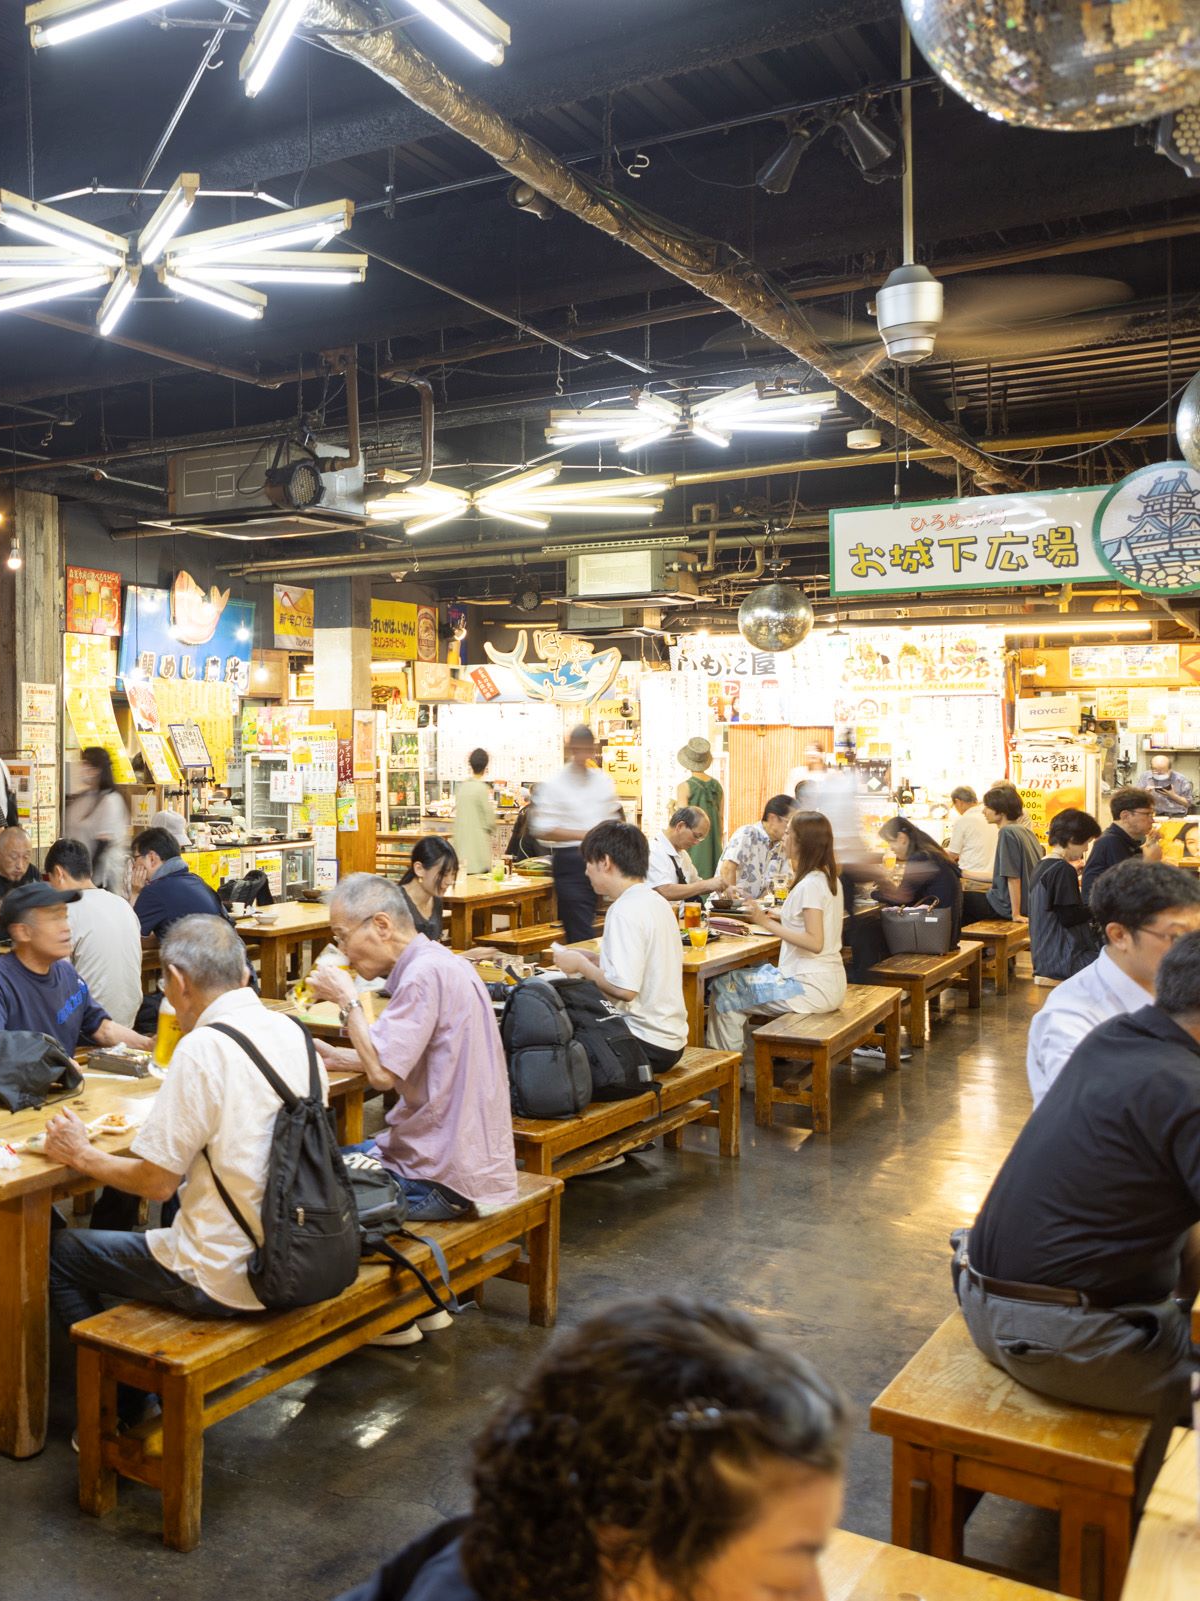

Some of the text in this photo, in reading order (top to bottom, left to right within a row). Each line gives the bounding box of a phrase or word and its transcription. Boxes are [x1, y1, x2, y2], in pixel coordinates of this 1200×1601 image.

[848, 526, 1080, 577] お城下広場
[615, 749, 629, 762] 生
[607, 763, 638, 773] ビール
